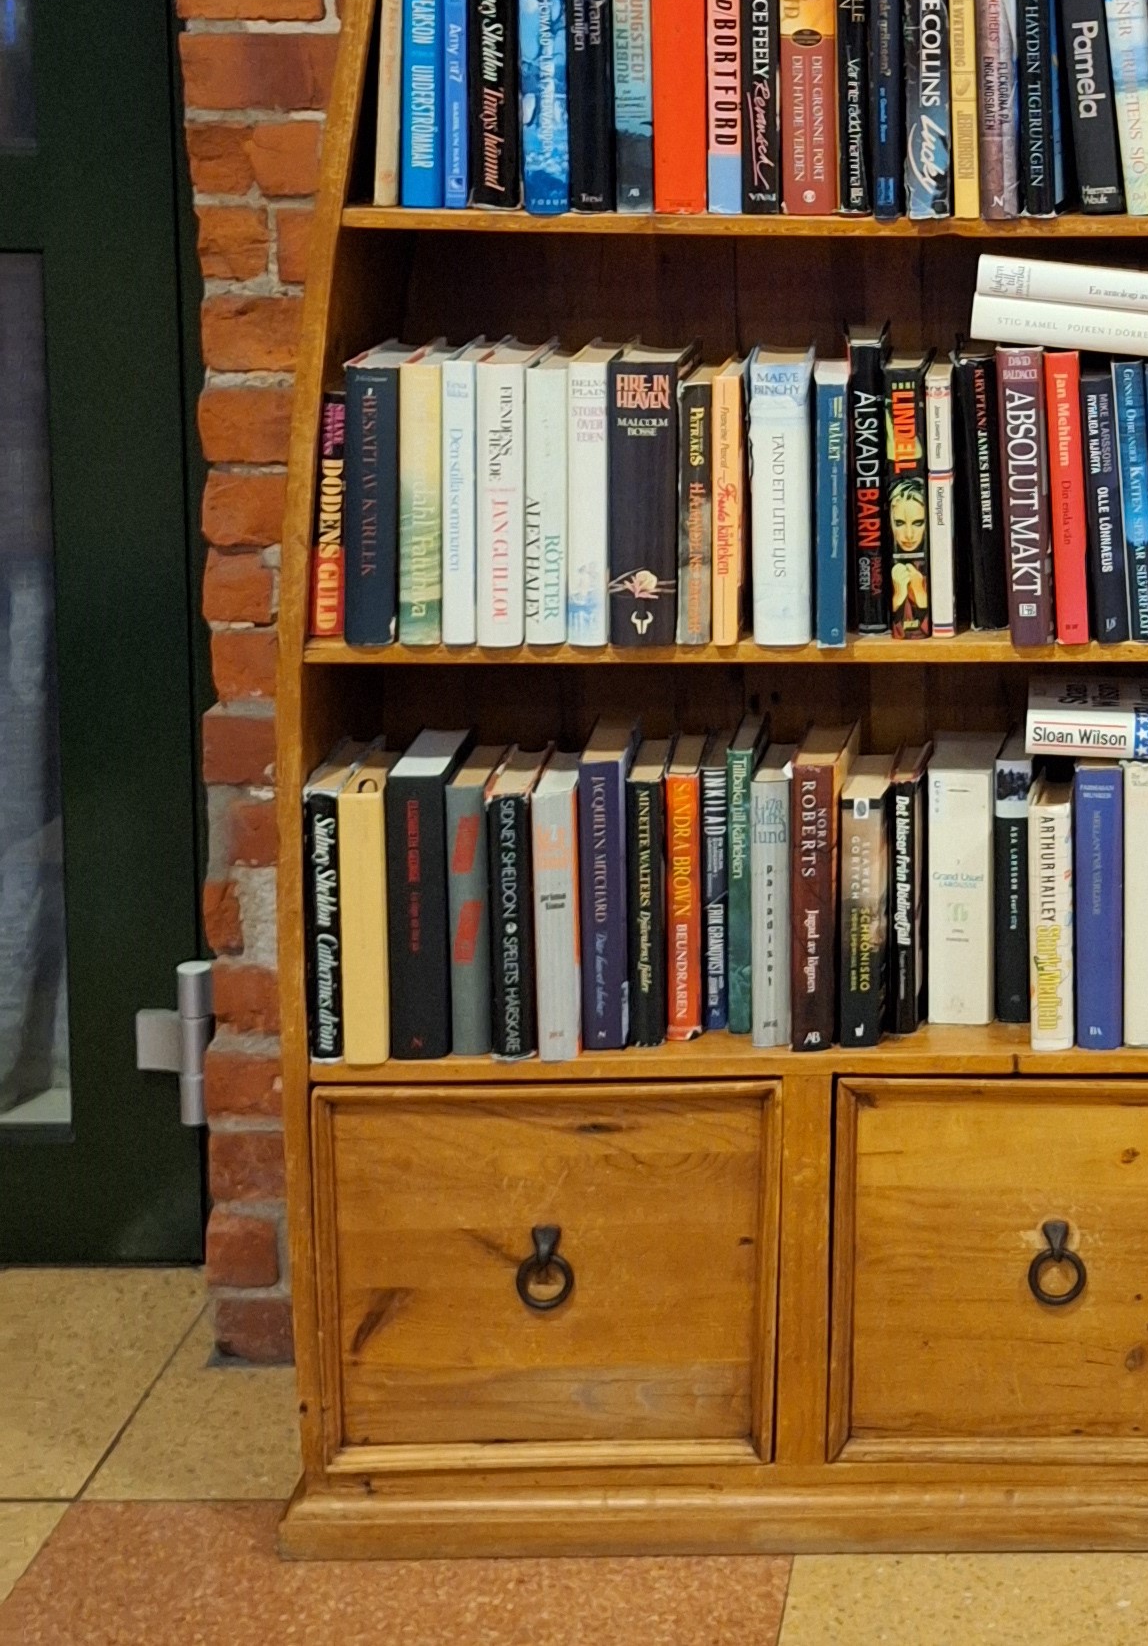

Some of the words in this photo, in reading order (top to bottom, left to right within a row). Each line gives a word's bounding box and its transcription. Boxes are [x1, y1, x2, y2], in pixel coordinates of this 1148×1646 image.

[447, 23, 461, 53] Amy
[482, 19, 504, 81] Sheldon
[752, 25, 769, 80] FEELY
[921, 14, 940, 107] COLLINS
[1026, 5, 1040, 73] HAYDEN
[714, 18, 741, 146] BORTFÖRD
[792, 56, 803, 83] DEN
[812, 56, 823, 84] DEN
[1071, 20, 1106, 119] Pamela
[411, 65, 438, 168] UNDERSTRÖMMAR
[792, 86, 803, 127] HVIDE
[793, 129, 804, 181] VERDEN
[1028, 81, 1044, 188] TIGERUNGEN
[812, 148, 824, 182] PORT
[997, 317, 1022, 327] STIG
[616, 392, 671, 410] HEAVEN
[754, 385, 800, 395] BINCHY
[756, 373, 799, 382] MAEVE
[1054, 374, 1069, 398] Jan
[500, 386, 512, 456] FIENDENS
[617, 418, 669, 426] MALCOLM
[1099, 393, 1110, 416] MIKE
[828, 421, 842, 461] MÅLET
[892, 391, 916, 474] LINDELL
[1005, 388, 1038, 510] ABSOLUT
[1056, 403, 1070, 466] Mehlum
[1100, 422, 1112, 472] LARSSONS
[320, 459, 346, 557] DÖDENS
[773, 478, 785, 503] ETT
[979, 473, 993, 530] HERBERT
[1062, 502, 1072, 524] enda
[1097, 487, 1109, 513] OLLE
[1129, 466, 1144, 513] KATTEN
[491, 498, 507, 533] JAN
[773, 508, 785, 543] LITET
[544, 534, 562, 620] RÖTTER
[859, 556, 871, 591] GREEN
[1011, 515, 1041, 596] MAKT
[317, 562, 340, 630] GULD
[1033, 727, 1073, 743] Sloan
[1079, 729, 1127, 746] Wilson
[703, 771, 726, 836] INKILAD
[732, 757, 746, 806] Tillbaka
[896, 795, 909, 817] Det
[500, 800, 514, 848] SIDNEY
[636, 789, 650, 847] MINETTE
[672, 782, 691, 850] SANDRA
[733, 807, 746, 821] till
[801, 781, 816, 877] ROBERTS
[817, 808, 826, 849] NORA
[896, 818, 911, 853] blåser
[312, 814, 336, 866] Sidney
[733, 823, 745, 879] kärleken
[1040, 816, 1055, 870] ARTHUR
[502, 851, 517, 917] SHELDON
[639, 850, 650, 907] WALTERS
[672, 856, 692, 917] BROWN
[851, 836, 860, 899] GORTYCH
[896, 855, 911, 882] från
[315, 866, 337, 926] Sheldon
[1042, 876, 1056, 923] HAILEY
[804, 909, 819, 938] Jagad
[807, 941, 817, 954] av
[503, 937, 519, 984] SPELETS
[676, 923, 688, 1019] BEUNDRAREN
[804, 956, 819, 993] lögnen
